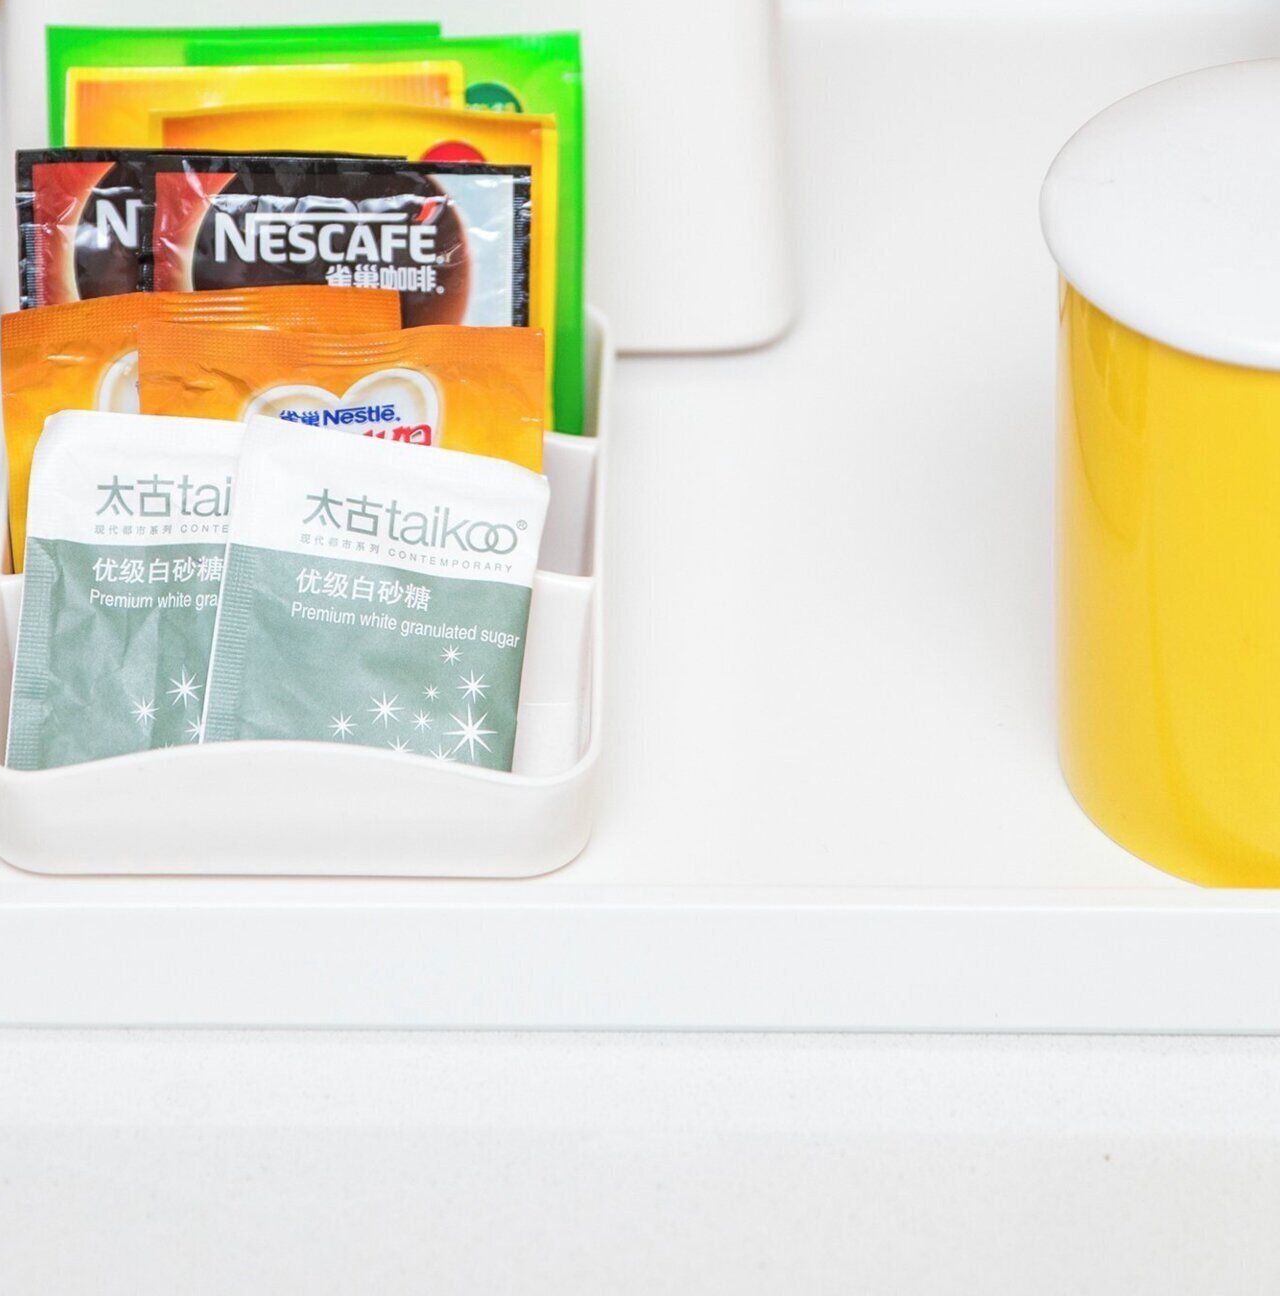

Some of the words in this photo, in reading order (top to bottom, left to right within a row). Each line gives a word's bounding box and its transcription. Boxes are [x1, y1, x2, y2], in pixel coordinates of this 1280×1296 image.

[92, 556, 224, 584] 优级白砂糖
[388, 548, 513, 573] CONTEMPORARY
[90, 589, 154, 609] Premium
[157, 592, 193, 609] white
[296, 567, 432, 611] 优级白砂糖
[291, 601, 356, 626] Premium
[359, 612, 398, 631] white
[400, 618, 478, 641] granulated
[480, 626, 521, 649] sugar
